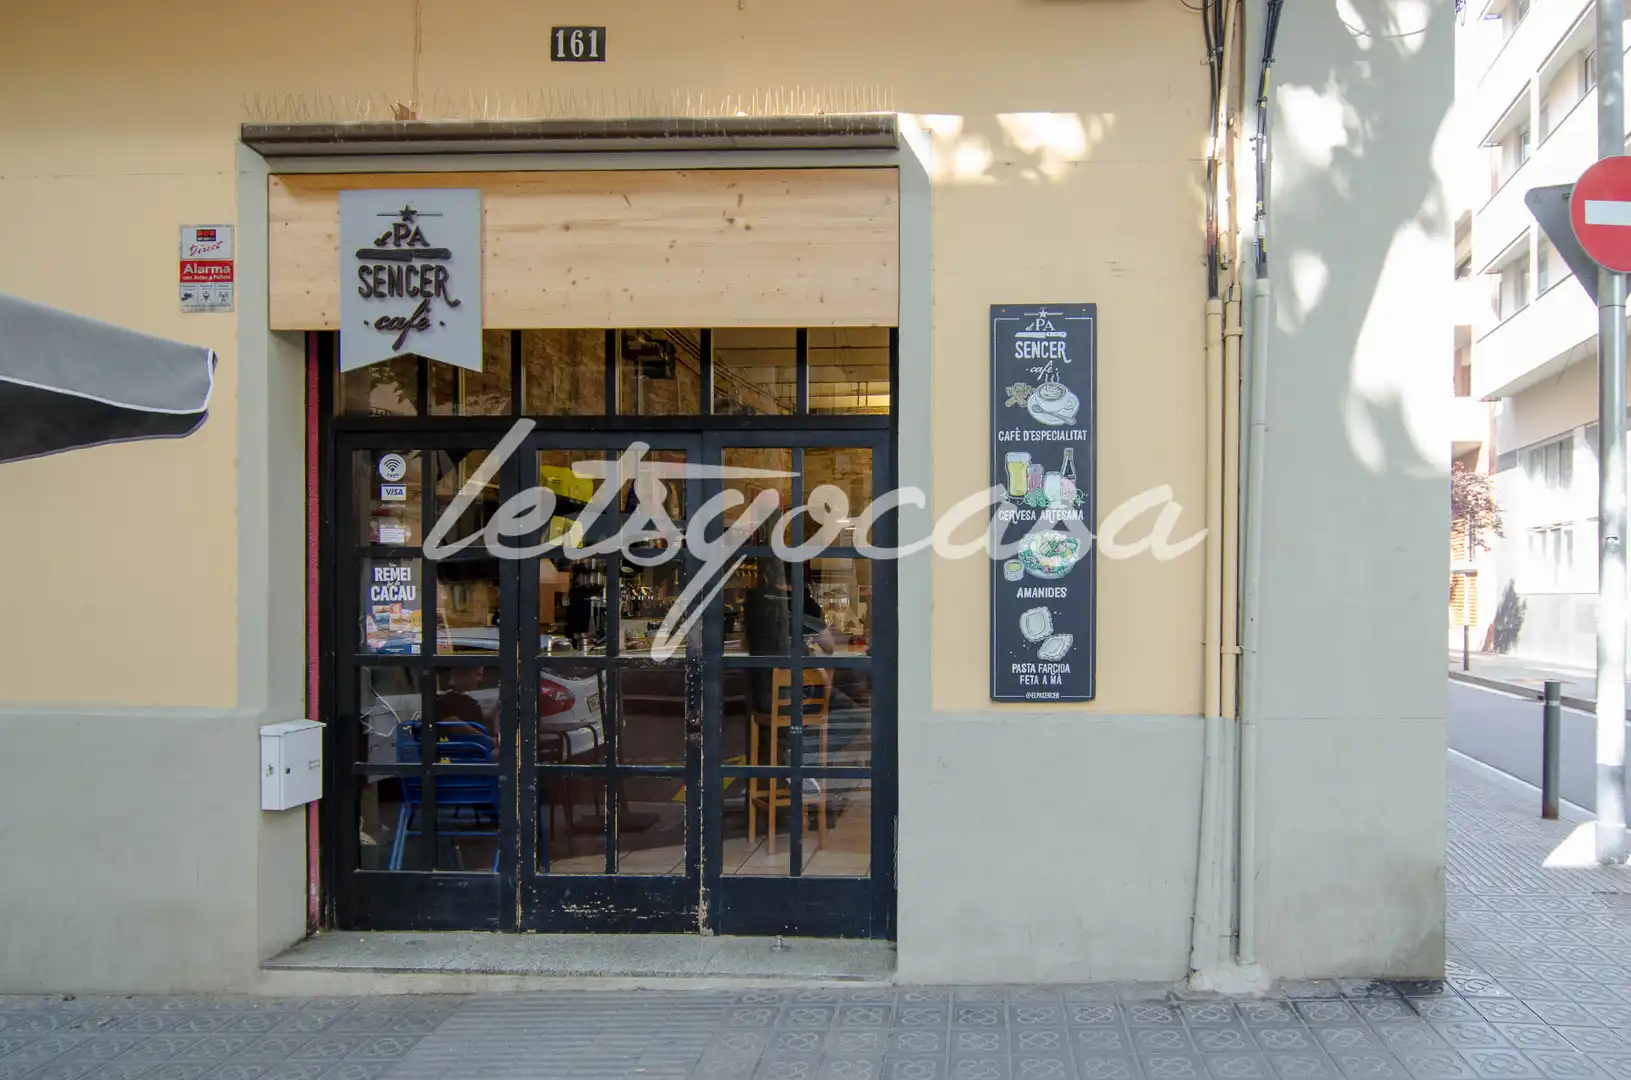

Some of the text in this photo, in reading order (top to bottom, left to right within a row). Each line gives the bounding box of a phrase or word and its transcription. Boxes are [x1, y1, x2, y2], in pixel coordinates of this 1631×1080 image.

[556, 29, 599, 58] 161
[392, 222, 431, 247] PA
[189, 240, 226, 256] Direct
[183, 263, 231, 274] Alarma
[358, 264, 461, 308] SENCER
[1025, 318, 1056, 331] el PA
[1014, 341, 1073, 363] SENCER
[1023, 430, 1088, 441] D'ESPECIALITAT
[385, 488, 404, 496] VISA
[998, 509, 1084, 524] CERVESA ARTESANA
[374, 567, 412, 581] REMEI
[370, 585, 416, 601] CACAU
[1016, 587, 1068, 598] AMANIDES
[1011, 663, 1036, 674] PASTA
[1019, 675, 1039, 685] FETA
[1042, 675, 1048, 685] A
